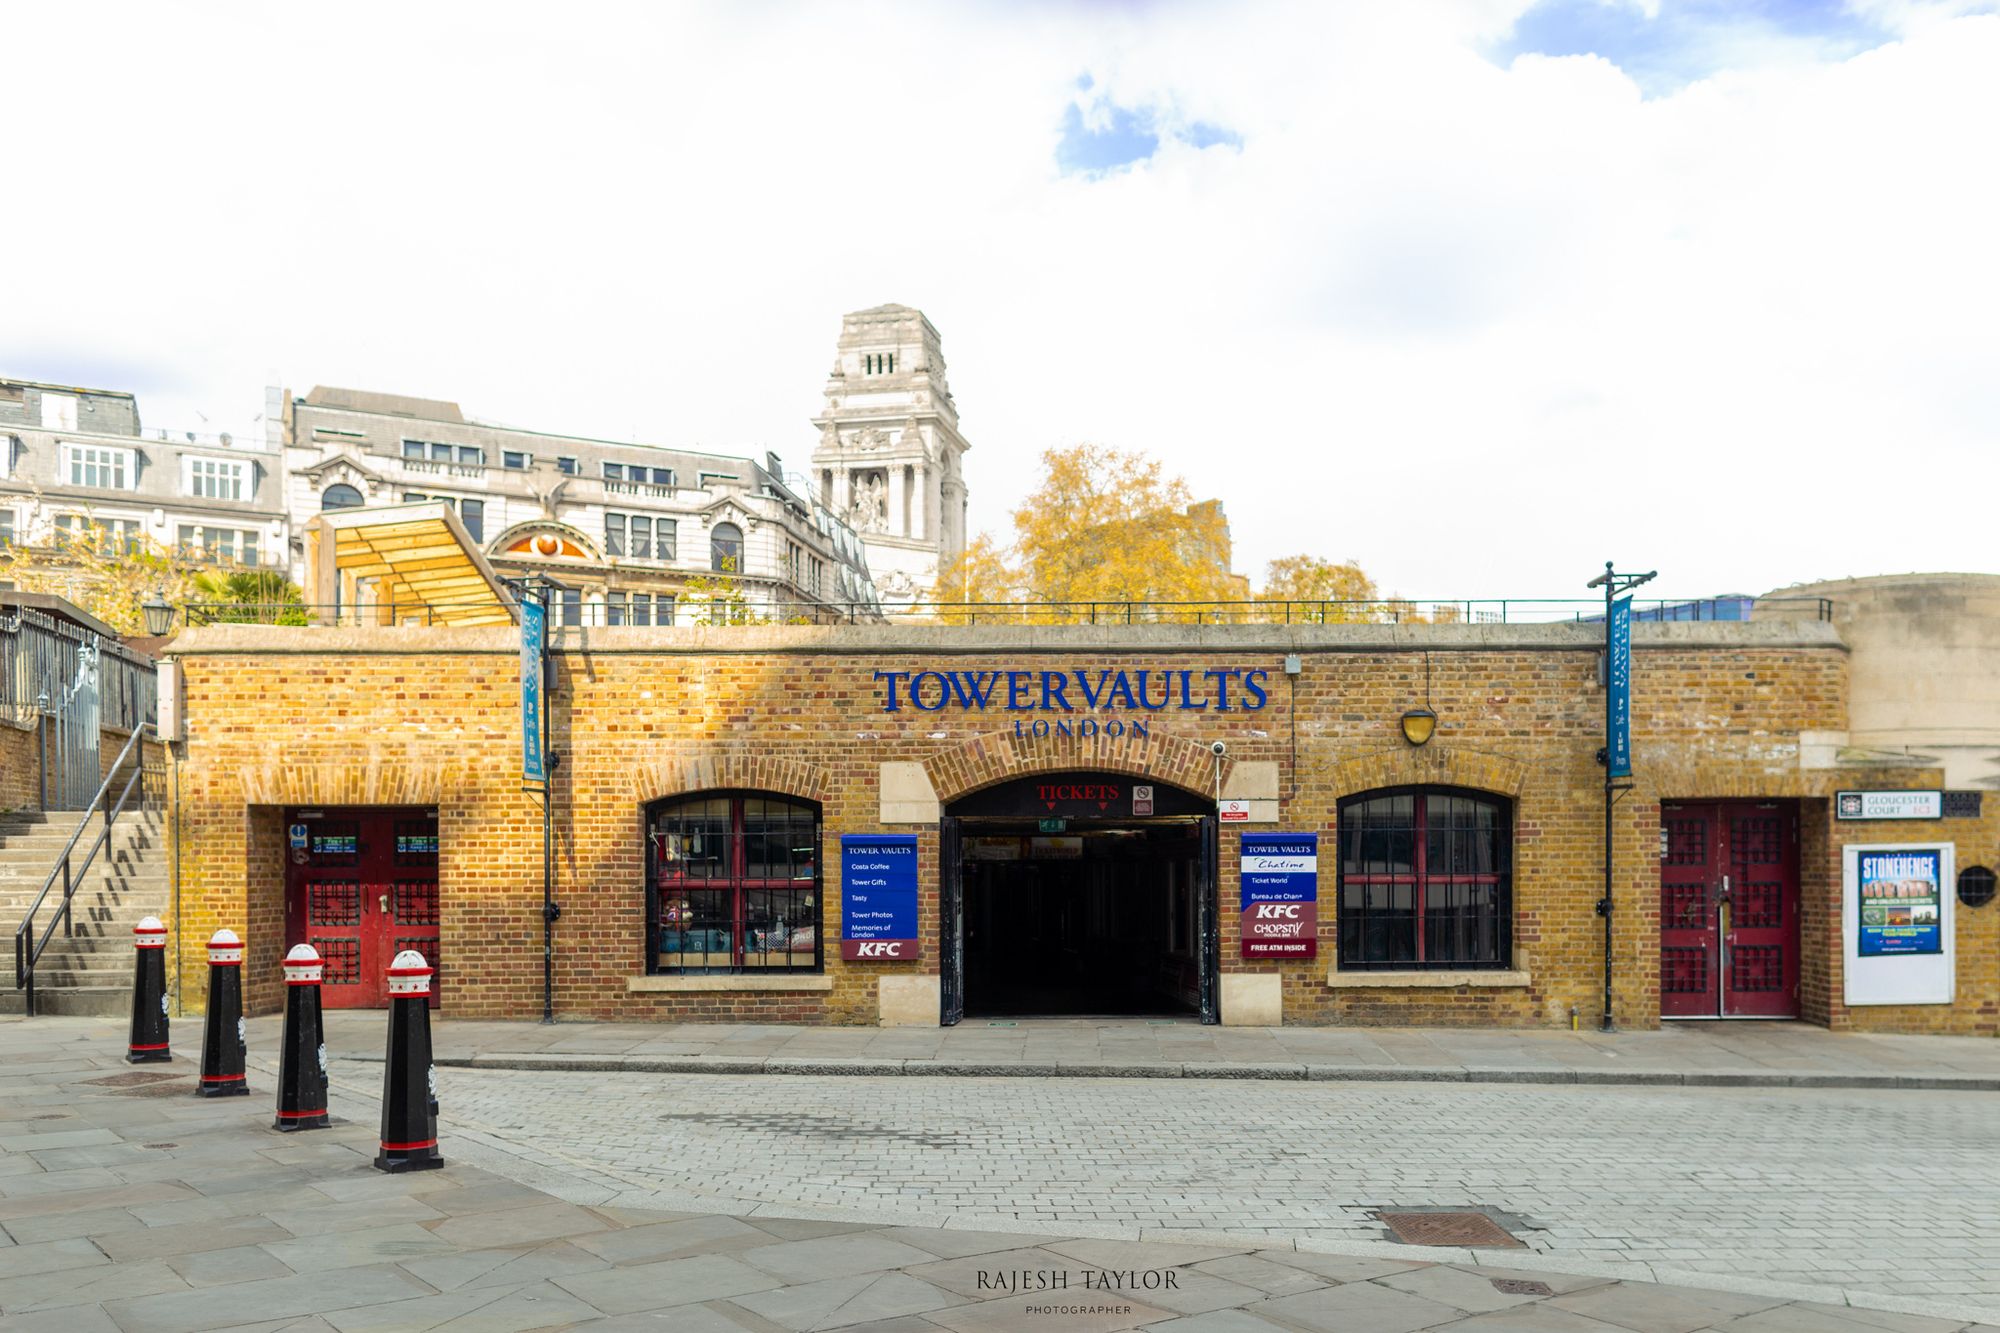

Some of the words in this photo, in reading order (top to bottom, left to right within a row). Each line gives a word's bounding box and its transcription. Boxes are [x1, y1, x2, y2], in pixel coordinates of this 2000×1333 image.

[1014, 719, 1150, 738] LONDON
[1037, 784, 1120, 800] TICKETS
[1867, 795, 1930, 805] GLOUCESTER
[1867, 806, 1901, 815] COURT
[1913, 805, 1931, 815] EC3
[848, 847, 879, 855] TOWER
[881, 847, 911, 855] VAULTS
[1258, 859, 1305, 869] Chatime
[1863, 857, 1935, 879] STONEHENGE
[1256, 905, 1300, 919] KFC
[857, 942, 901, 957] KFC
[1284, 944, 1306, 952] INSIDE
